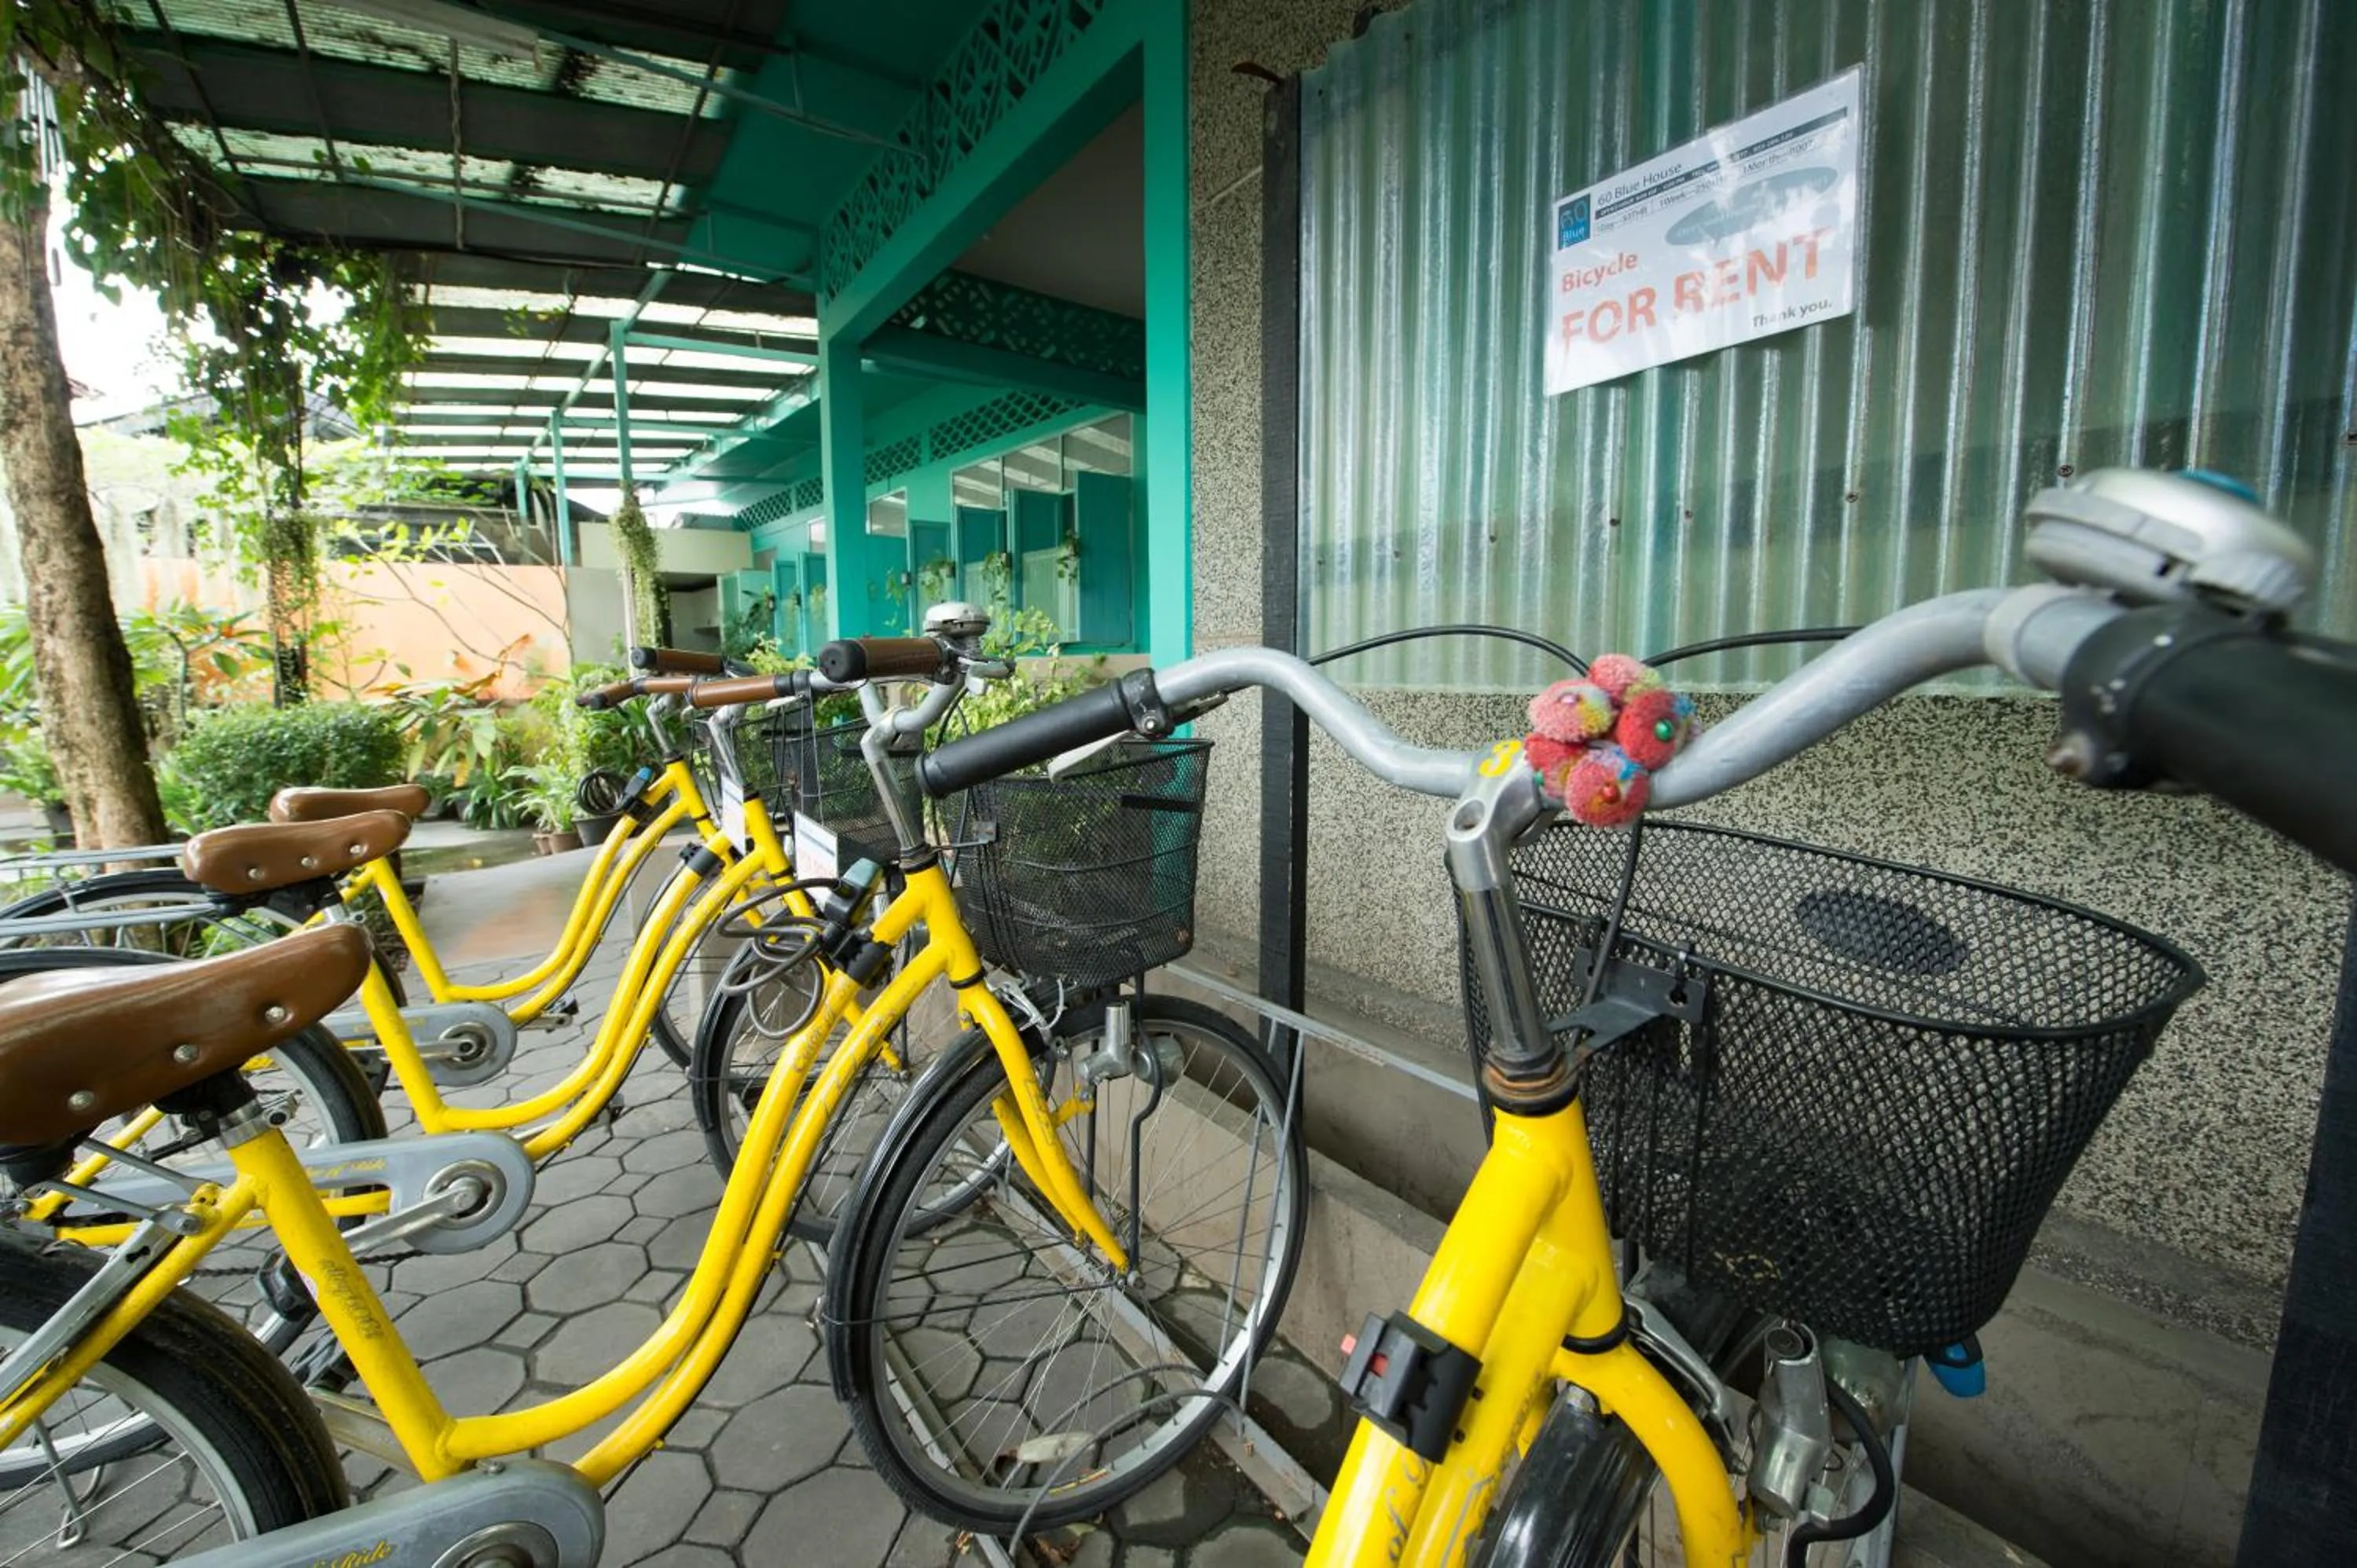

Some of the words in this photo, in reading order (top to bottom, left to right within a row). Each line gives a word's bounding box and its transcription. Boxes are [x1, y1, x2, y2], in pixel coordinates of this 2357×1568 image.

[1597, 192, 1613, 207] 60
[1615, 181, 1640, 200] Blue
[1643, 163, 1682, 187] House
[1562, 252, 1638, 293] Bicycle
[1562, 287, 1658, 351] FOR
[1673, 226, 1833, 314] RENT
[1799, 299, 1833, 318] you.
[1479, 739, 1522, 778] 3
